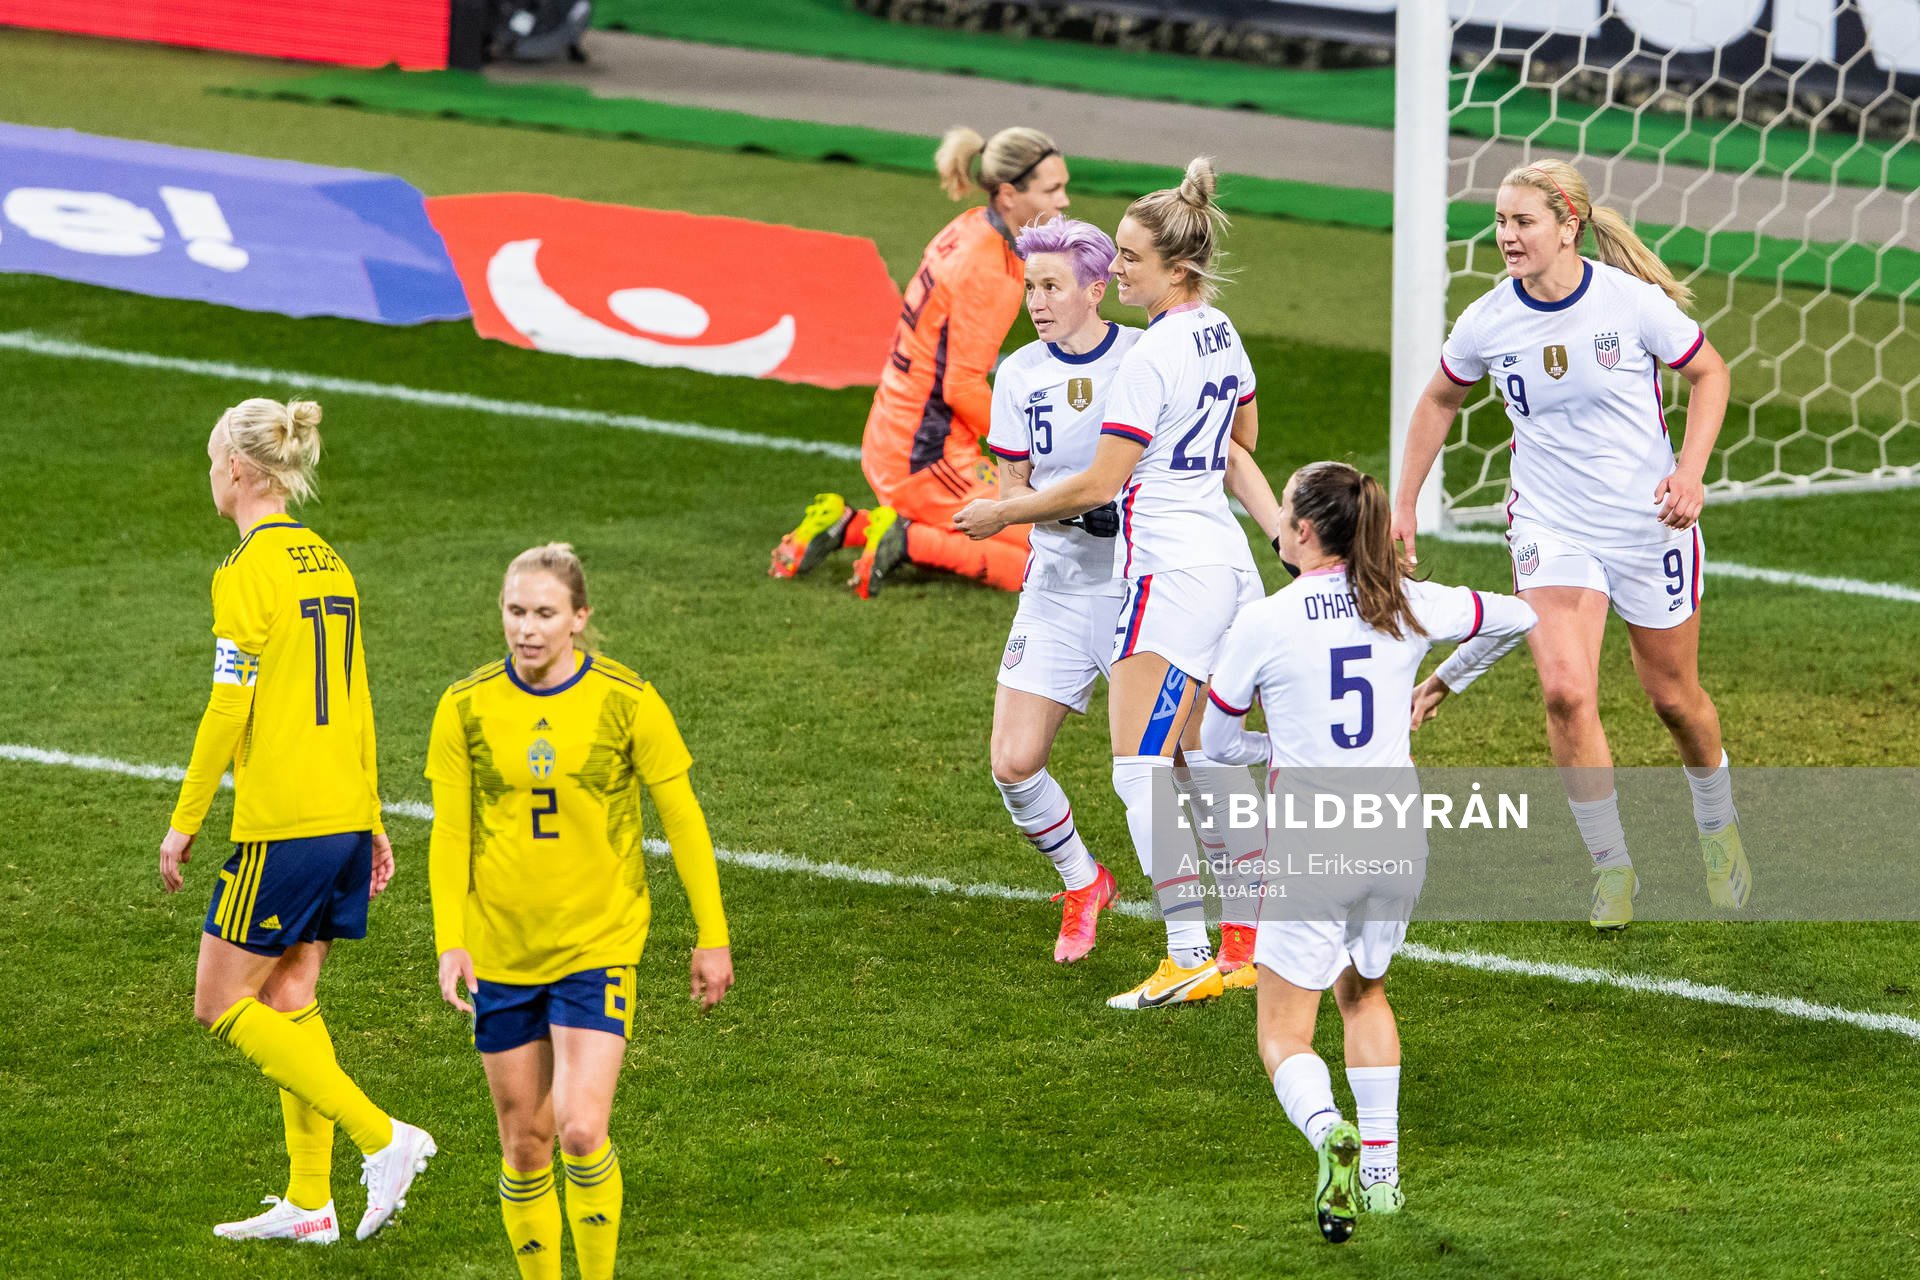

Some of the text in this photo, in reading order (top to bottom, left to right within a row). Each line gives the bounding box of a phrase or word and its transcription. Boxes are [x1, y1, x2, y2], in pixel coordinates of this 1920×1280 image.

[1597, 340, 1618, 352] USA
[1506, 374, 1530, 417] 9
[1024, 405, 1053, 455] 15
[1169, 375, 1239, 471] 22
[287, 545, 344, 574] SEGER
[1519, 548, 1536, 562] USA
[1662, 548, 1684, 596] 9
[299, 596, 356, 726] 17
[1008, 642, 1024, 653] USA
[1329, 644, 1374, 749] 5
[531, 787, 559, 840] 2
[604, 967, 627, 1021] 2
